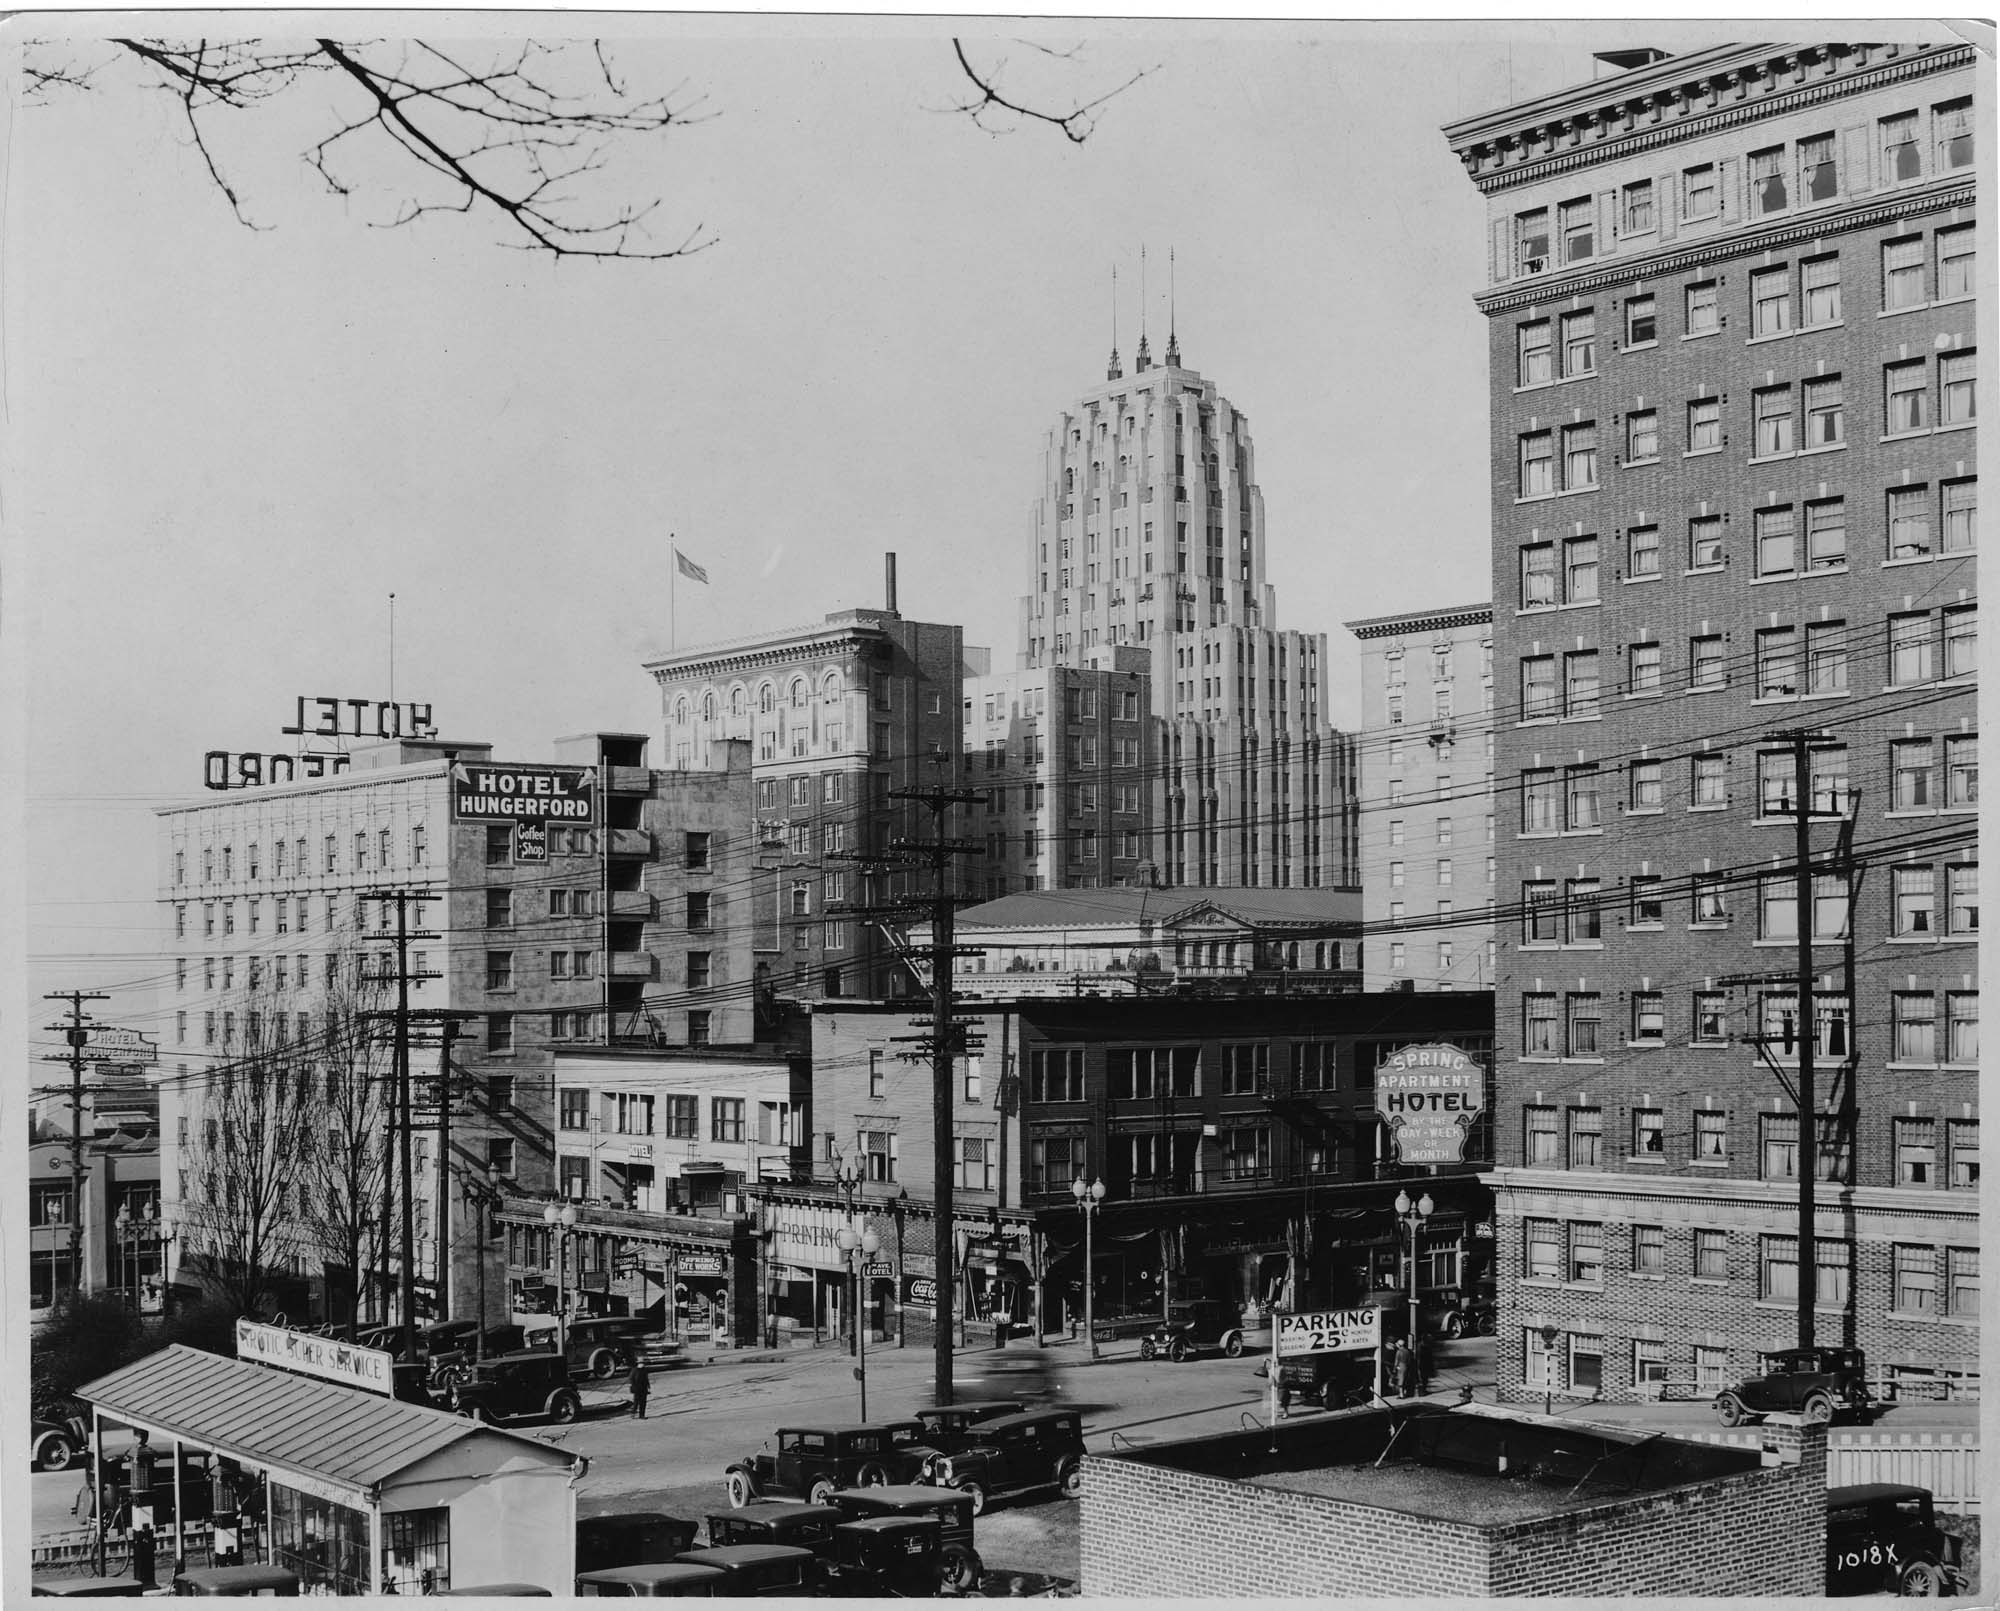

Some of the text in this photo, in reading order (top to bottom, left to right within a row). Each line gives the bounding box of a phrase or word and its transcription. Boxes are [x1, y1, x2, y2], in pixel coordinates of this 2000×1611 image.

[478, 773, 569, 795] HOTEL
[460, 795, 589, 817] HUNGERFORD
[517, 823, 545, 841] Coffee
[522, 841, 544, 859] Shop
[101, 1033, 137, 1045] HOTEL
[1393, 1051, 1465, 1072] SPRING
[1387, 1092, 1478, 1113] HOTEL
[1428, 1116, 1446, 1126] THE
[1423, 1139, 1438, 1148] OR
[1410, 1150, 1449, 1160] MONTH
[614, 1256, 637, 1265] ROOMS
[695, 1261, 720, 1271] WORKS
[1280, 1309, 1375, 1334] PARKING
[287, 1338, 324, 1367] SUPER
